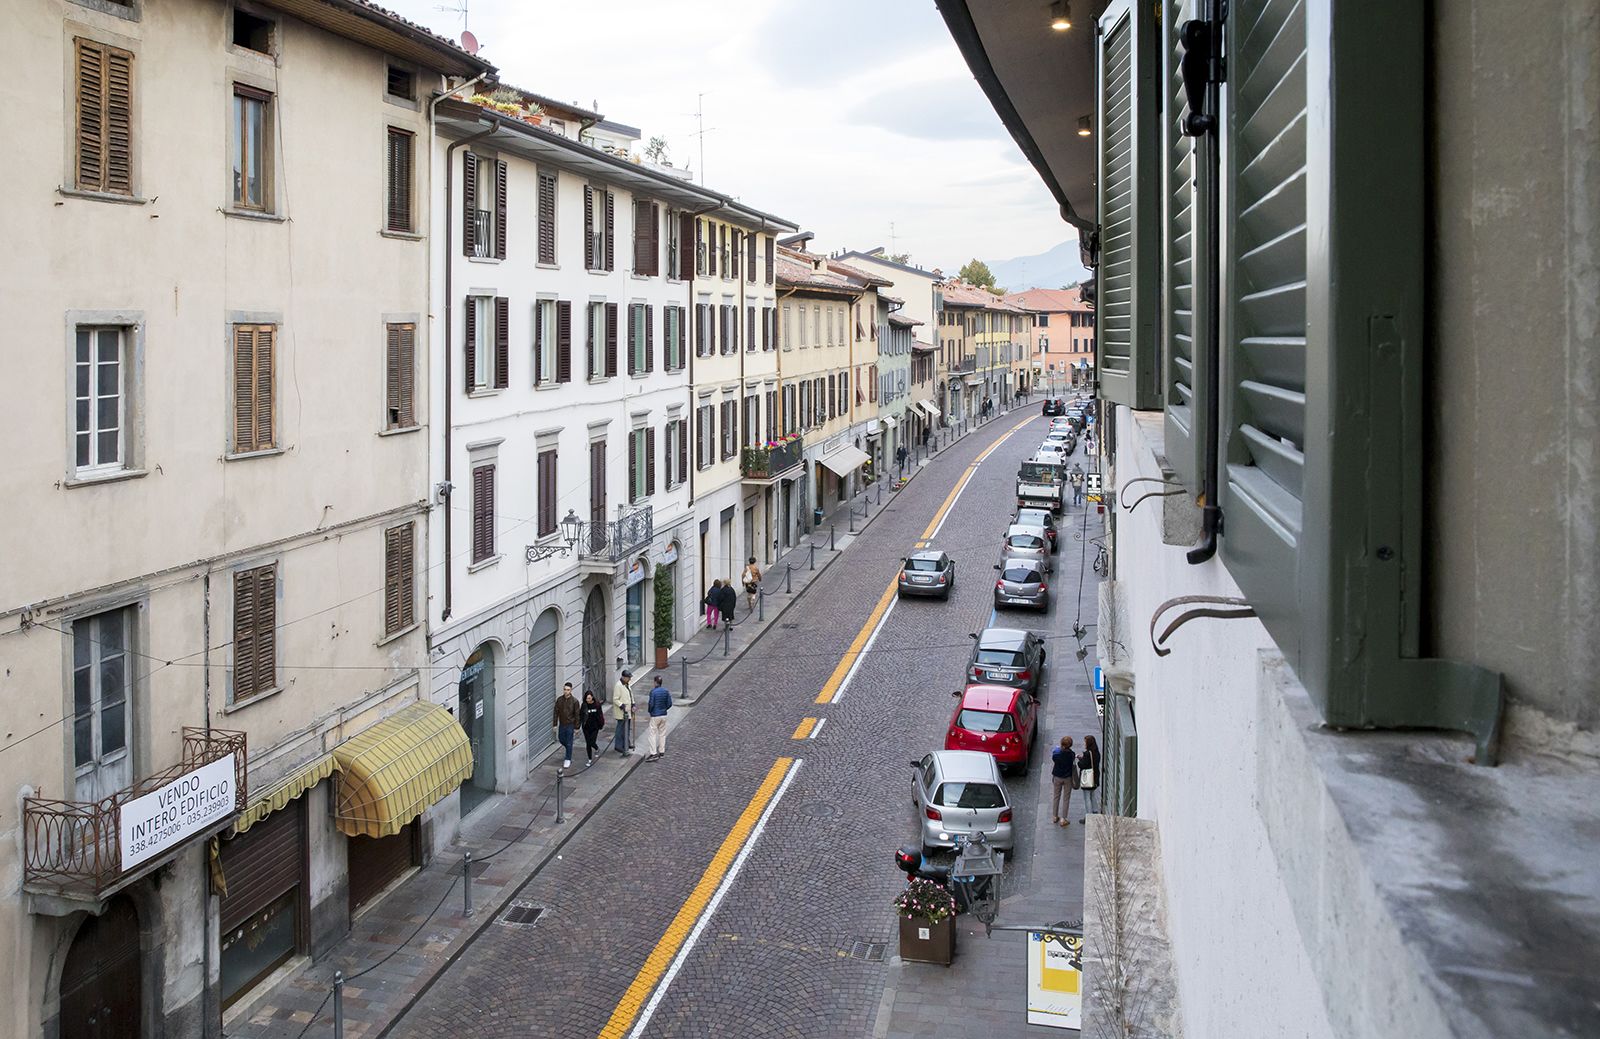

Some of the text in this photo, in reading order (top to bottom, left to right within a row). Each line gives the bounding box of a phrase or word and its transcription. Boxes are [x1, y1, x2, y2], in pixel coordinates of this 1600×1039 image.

[131, 806, 177, 841] INTERO
[180, 780, 229, 816] EDIFICIO
[158, 775, 200, 809] VENDO
[129, 823, 182, 857] 338.4275006
[186, 796, 229, 825] 035.239903
